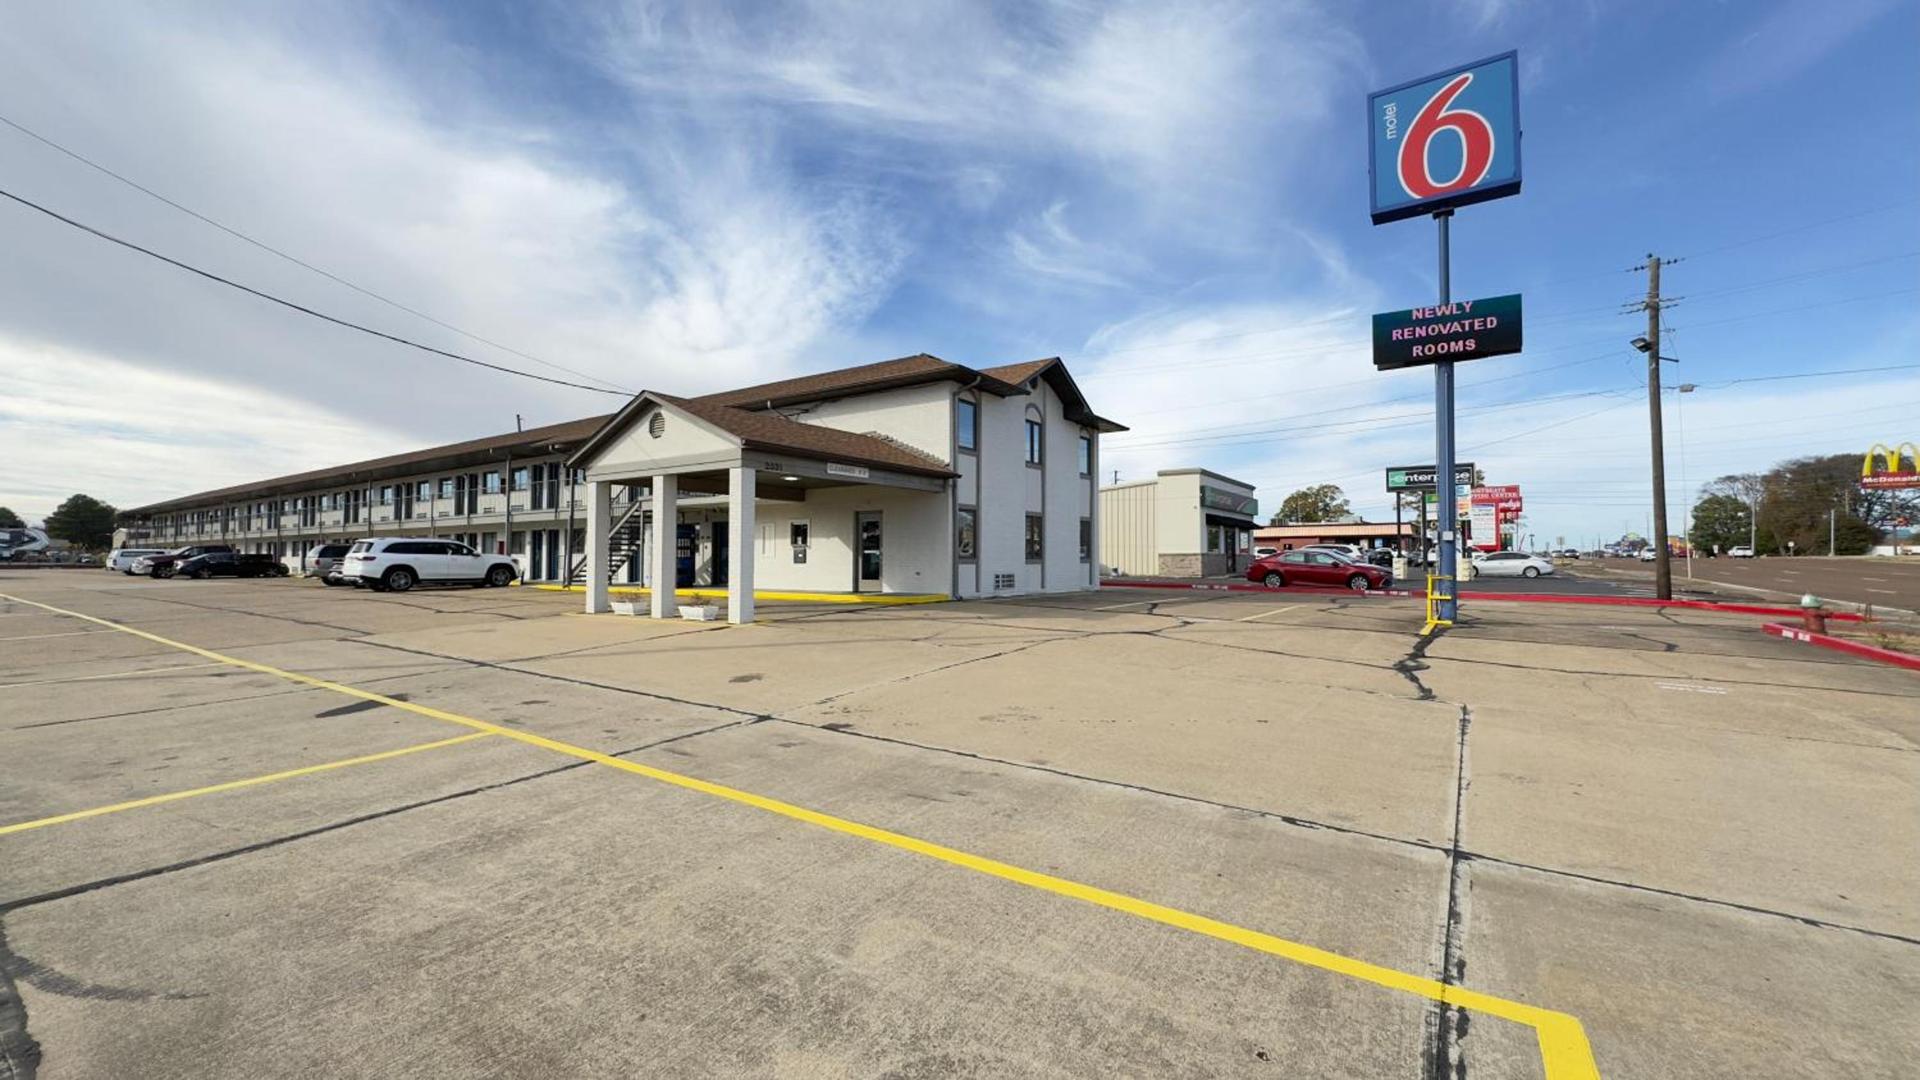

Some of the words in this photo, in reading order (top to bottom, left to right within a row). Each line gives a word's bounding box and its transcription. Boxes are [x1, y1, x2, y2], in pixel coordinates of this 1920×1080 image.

[1383, 102, 1397, 140] motel
[1397, 72, 1495, 199] 6
[1412, 301, 1473, 321] NEWLY
[1391, 316, 1498, 341] RENOVATED
[1412, 338, 1476, 357] ROOMS
